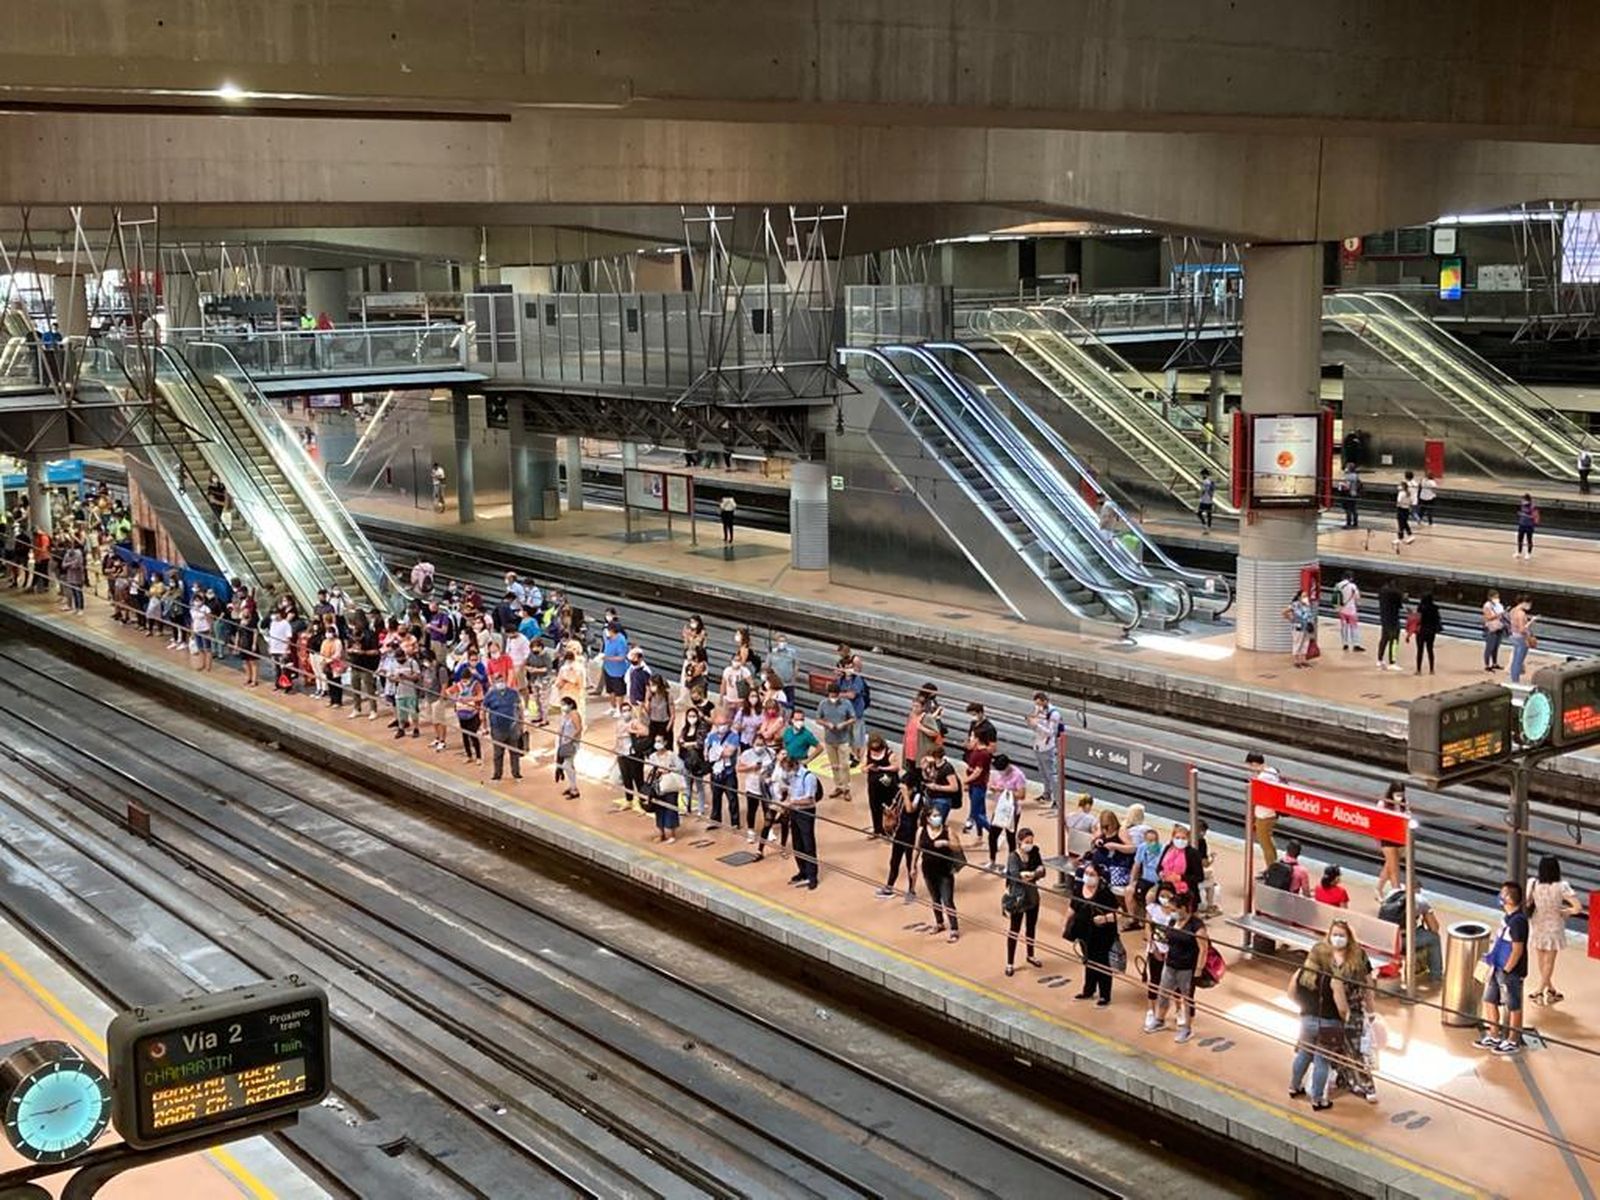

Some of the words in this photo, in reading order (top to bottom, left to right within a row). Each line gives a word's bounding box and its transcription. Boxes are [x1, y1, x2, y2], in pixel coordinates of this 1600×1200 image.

[1285, 793, 1320, 815] Madrid
[1333, 806, 1370, 829] Atocha
[228, 1024, 243, 1043] 2
[280, 1020, 301, 1031] tren
[273, 1043, 278, 1054] 1
[144, 1053, 233, 1086] CHAMARTIN
